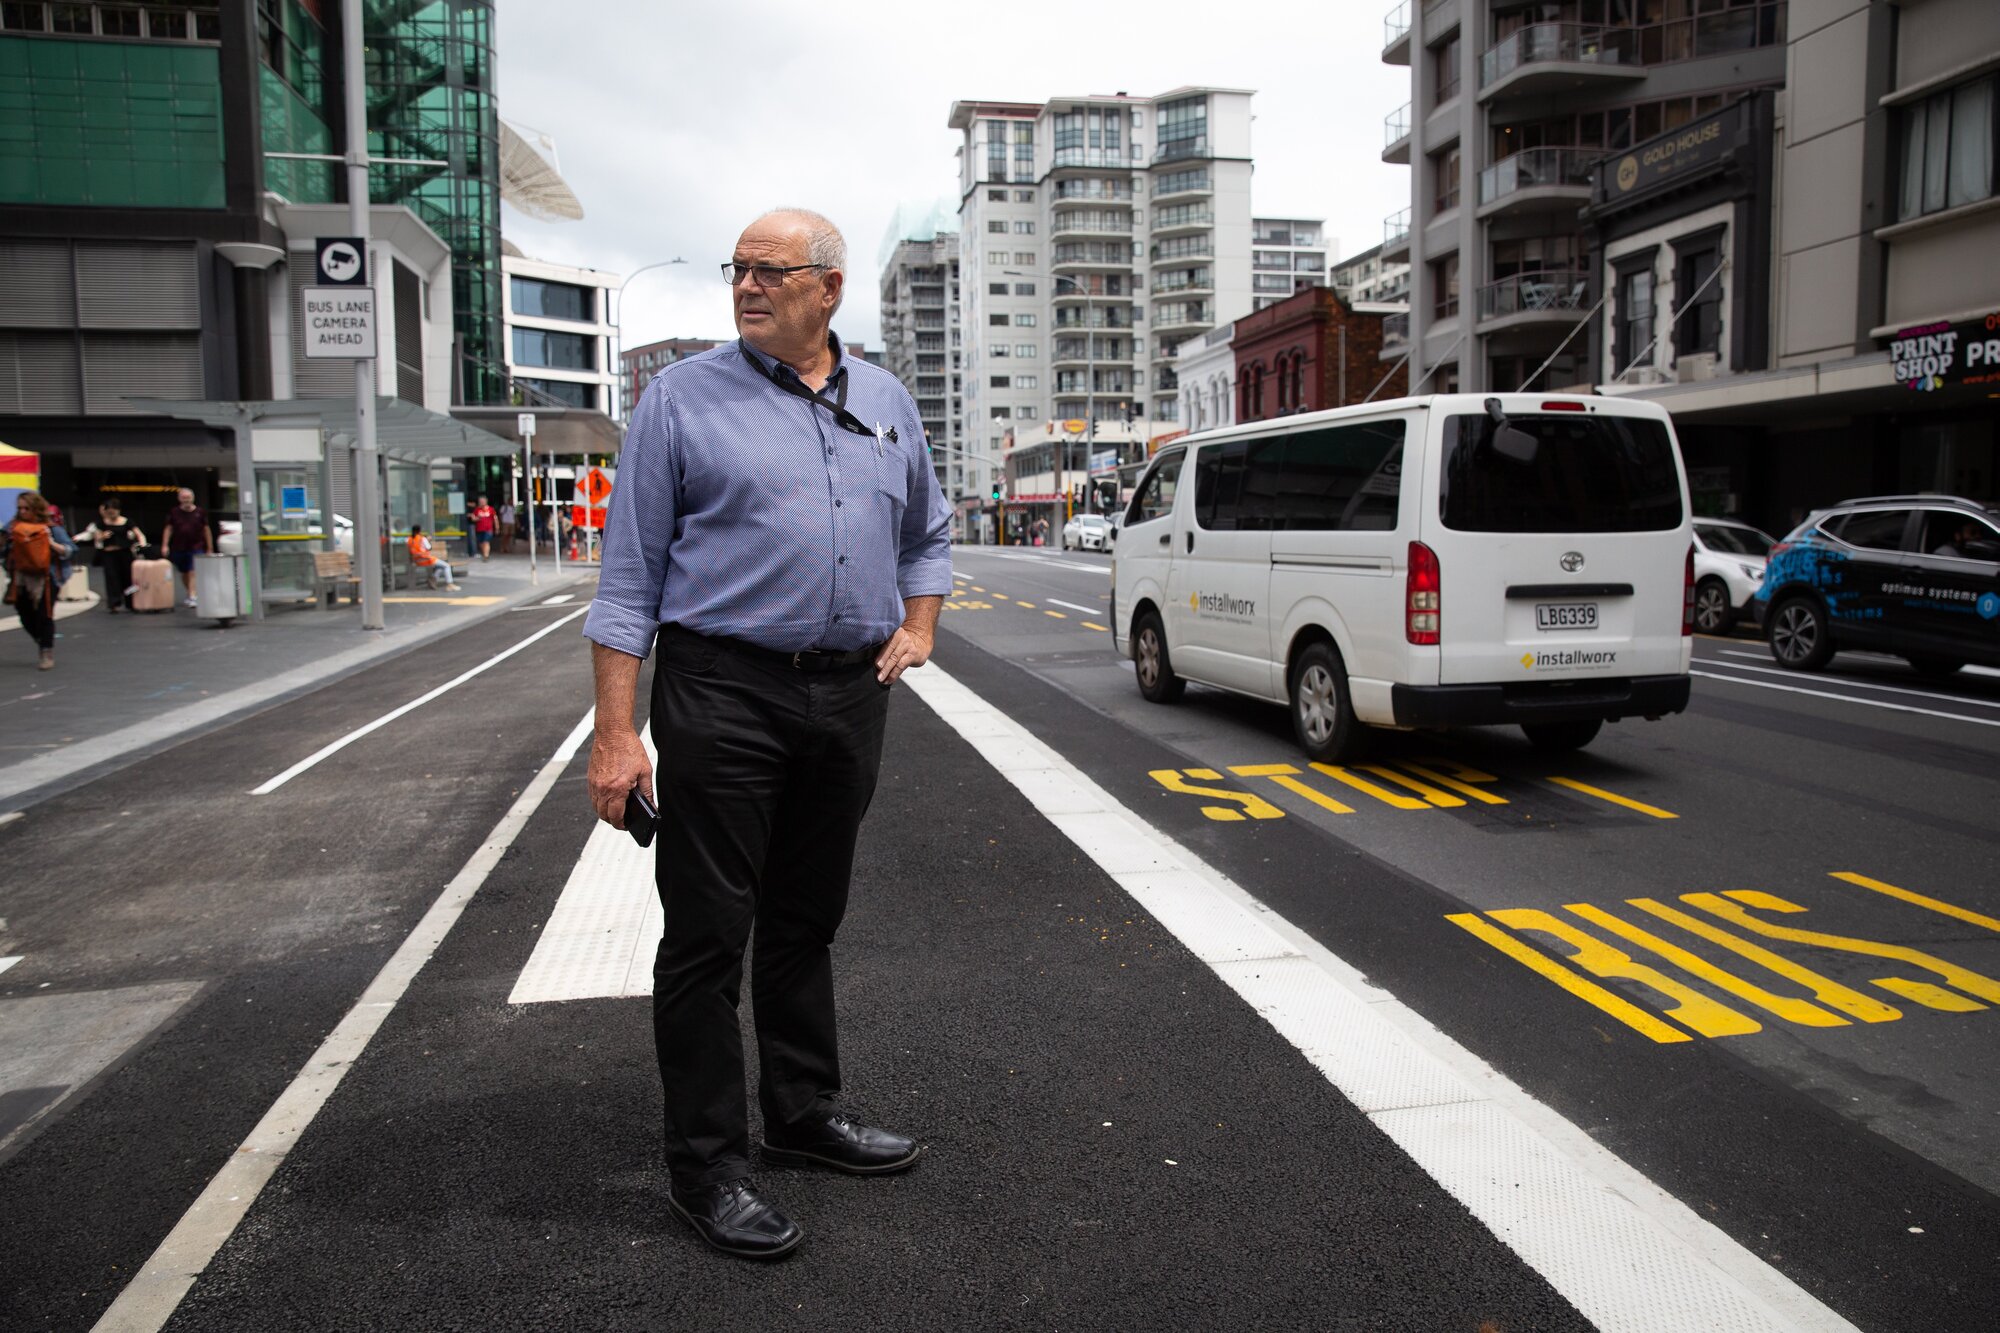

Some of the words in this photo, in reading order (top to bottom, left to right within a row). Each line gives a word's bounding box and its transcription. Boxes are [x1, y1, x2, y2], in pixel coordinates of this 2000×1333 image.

[1642, 141, 1676, 167] GOLD
[1677, 121, 1721, 153] HOUSE
[307, 301, 334, 313] BUS
[337, 301, 371, 313] LANE
[312, 317, 367, 329] CAMERA
[318, 333, 363, 345] AHEAD
[1890, 331, 1958, 362] PRINT
[1895, 354, 1953, 381] SHOP
[1200, 590, 1255, 616] installworx
[1881, 582, 1925, 596] optimus
[1928, 587, 1978, 602] systems
[1539, 607, 1596, 626] LBG339
[1536, 650, 1616, 666] installworx
[1148, 756, 1511, 821] STOP
[1443, 889, 2000, 1043] BUS
